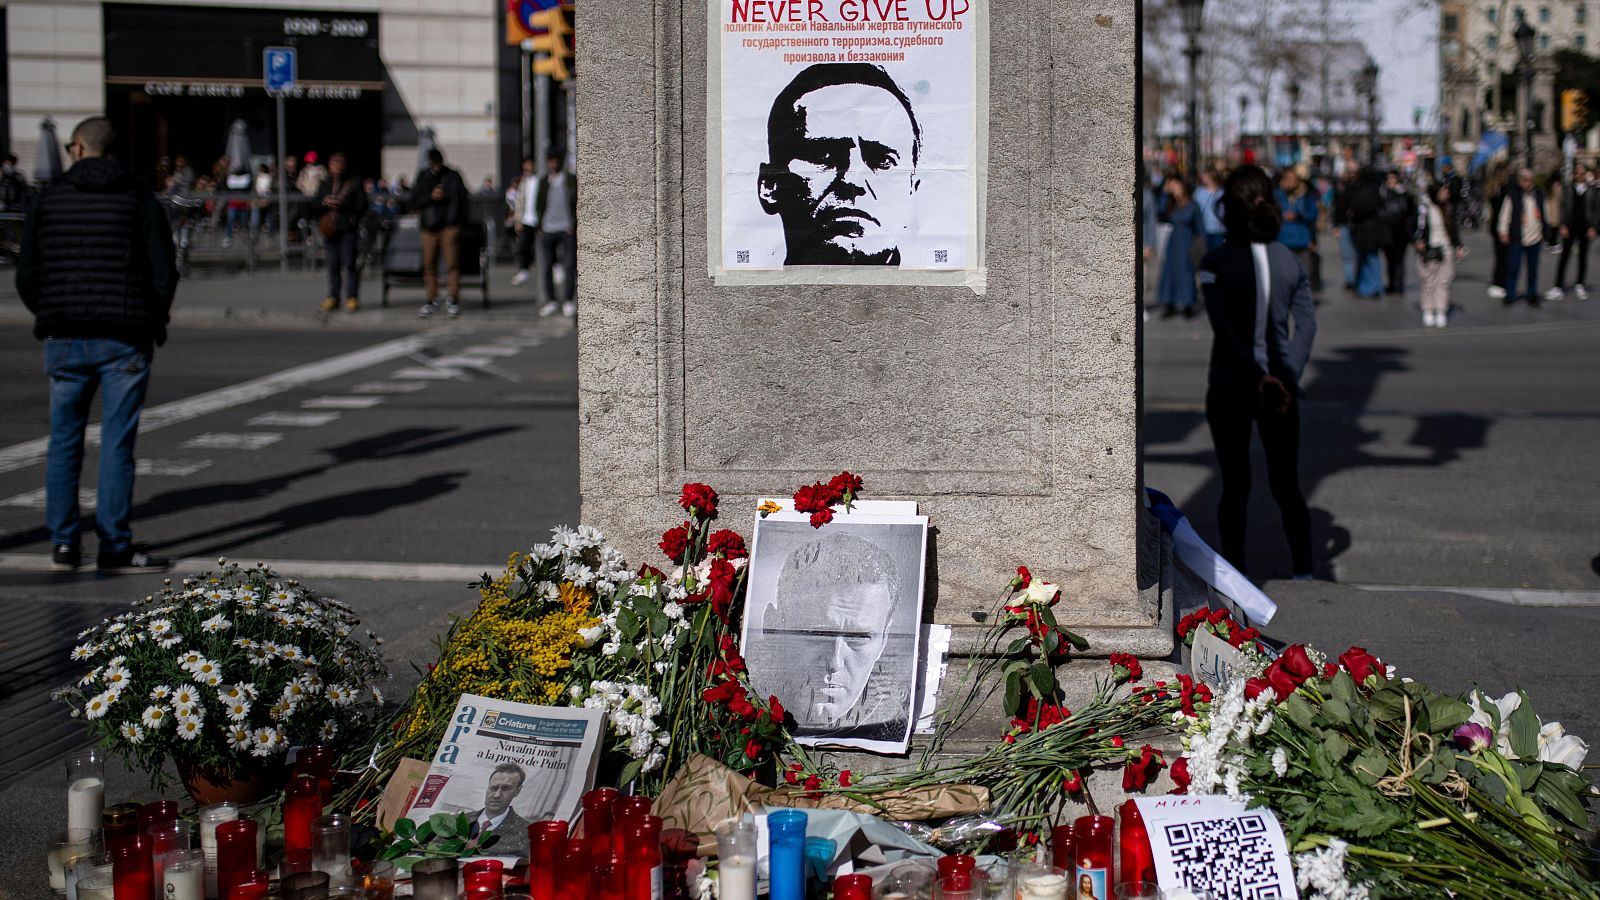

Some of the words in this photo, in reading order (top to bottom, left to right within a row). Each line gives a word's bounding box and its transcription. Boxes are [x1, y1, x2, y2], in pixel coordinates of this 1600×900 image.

[731, 0, 829, 23] NEVER
[840, 0, 909, 21] GIVE
[925, 0, 969, 21] UP
[766, 20, 807, 32] Алексей
[868, 20, 904, 33] жертва
[907, 20, 962, 33] путинского
[742, 37, 829, 50] государственного
[784, 52, 836, 65] произвола
[838, 53, 845, 61] и
[847, 50, 905, 61] беззакония
[498, 717, 537, 731] Criatures
[496, 740, 537, 755] Navalni
[537, 749, 558, 758] mor
[476, 750, 484, 758] a
[485, 749, 495, 760] la
[495, 752, 526, 764] presó
[526, 755, 539, 766] de
[541, 758, 567, 770] Putin
[1155, 799, 1201, 808] MIRA
